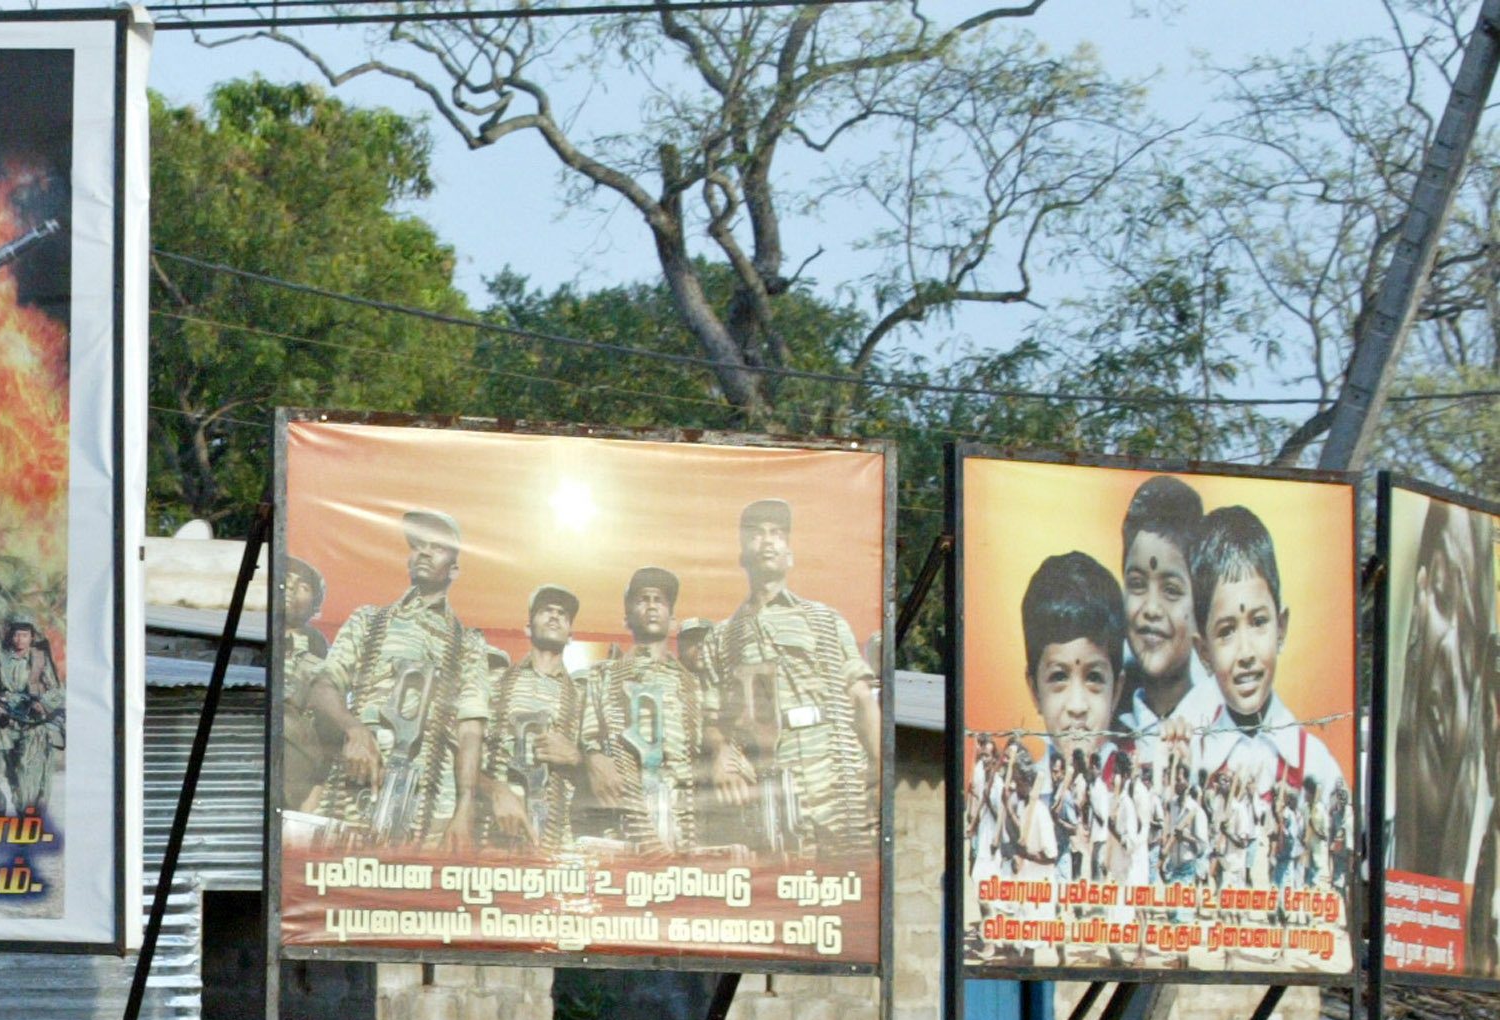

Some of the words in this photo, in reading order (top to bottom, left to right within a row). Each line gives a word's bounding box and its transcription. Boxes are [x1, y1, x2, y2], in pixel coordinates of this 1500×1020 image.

[305, 857, 433, 895] புலியென
[441, 862, 586, 905] எழுவதாய்
[594, 865, 751, 907] உறுதியெடு
[777, 870, 862, 906] எந்தப்
[1057, 878, 1118, 911] புலிகள்
[1123, 882, 1197, 908] படையில்
[326, 905, 472, 944] புயலையும்
[668, 918, 775, 943] கவலை
[783, 915, 843, 954] விடு
[983, 913, 1065, 947] விளையும்
[1071, 917, 1140, 944] பயிர்கள்
